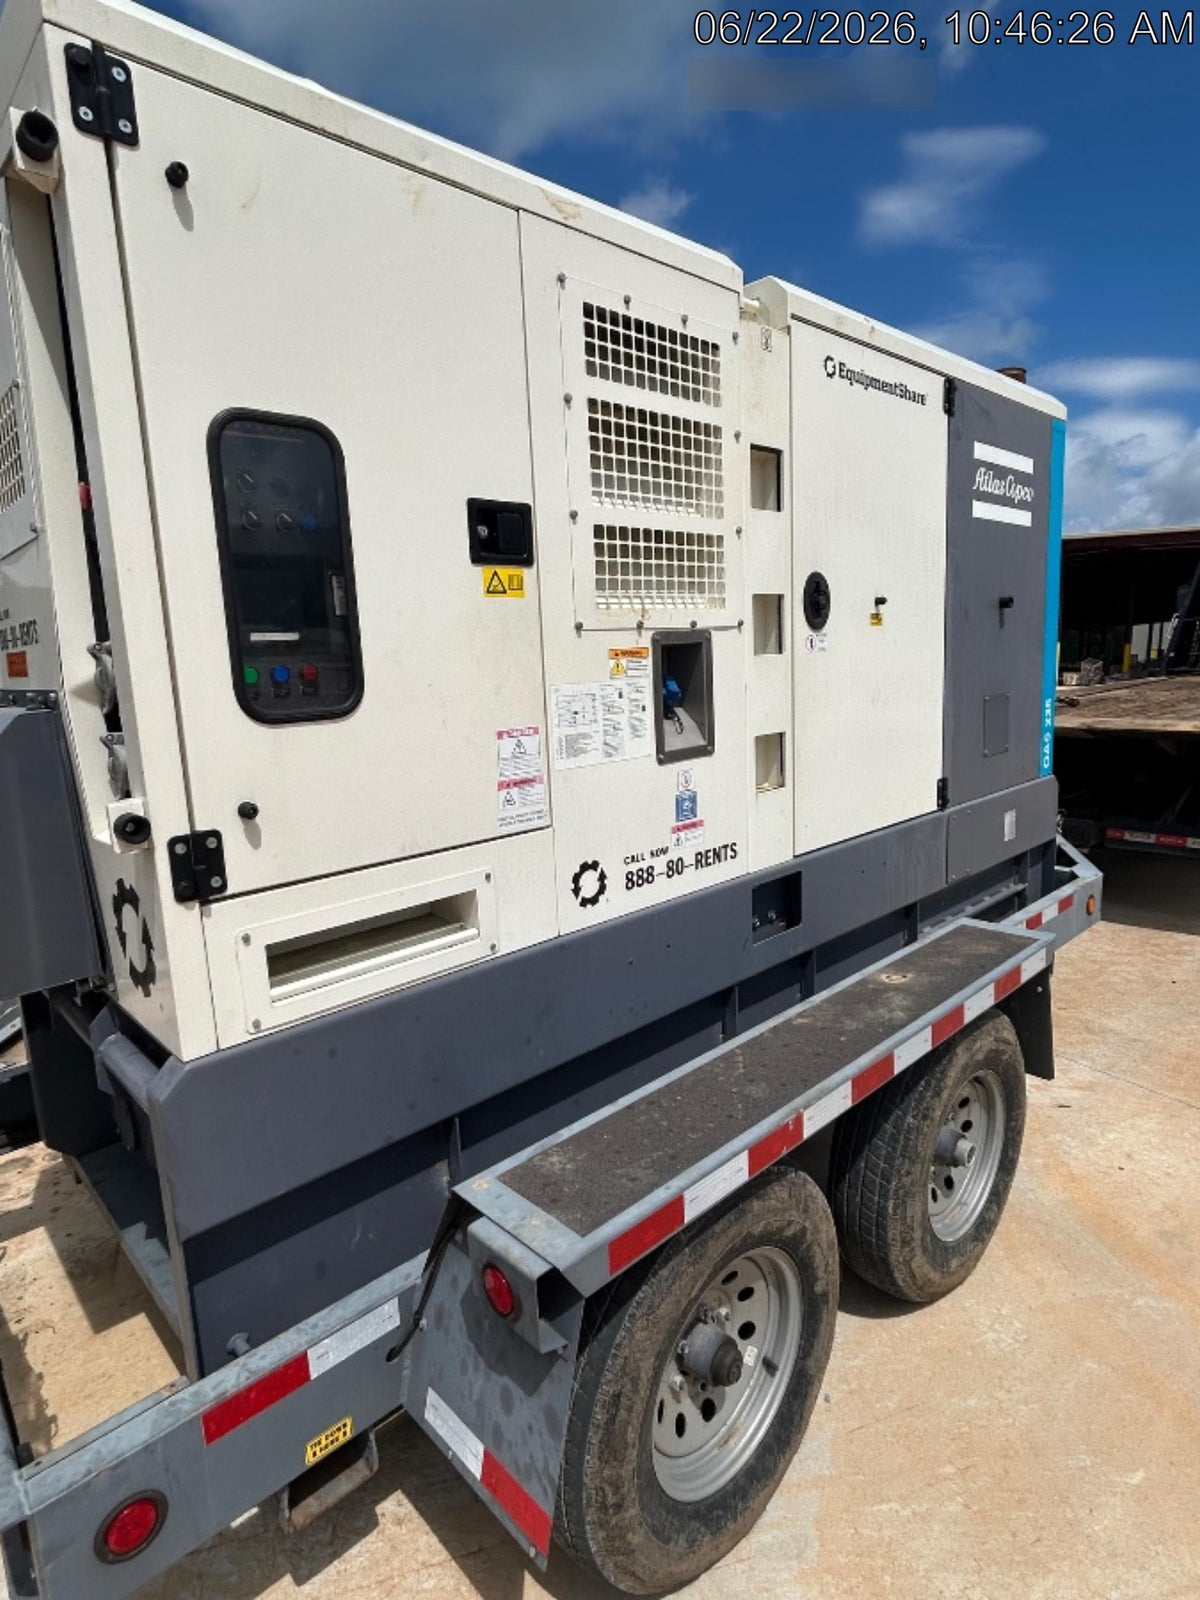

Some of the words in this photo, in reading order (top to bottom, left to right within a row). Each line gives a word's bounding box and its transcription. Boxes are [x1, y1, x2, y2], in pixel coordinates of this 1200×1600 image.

[838, 361, 927, 406] EquipmentShare
[972, 467, 1005, 496] Atlas
[1005, 475, 1034, 504] Copco
[623, 853, 646, 866] CALL
[650, 845, 669, 858] NOW
[624, 842, 738, 891] 888-80-RENTS
